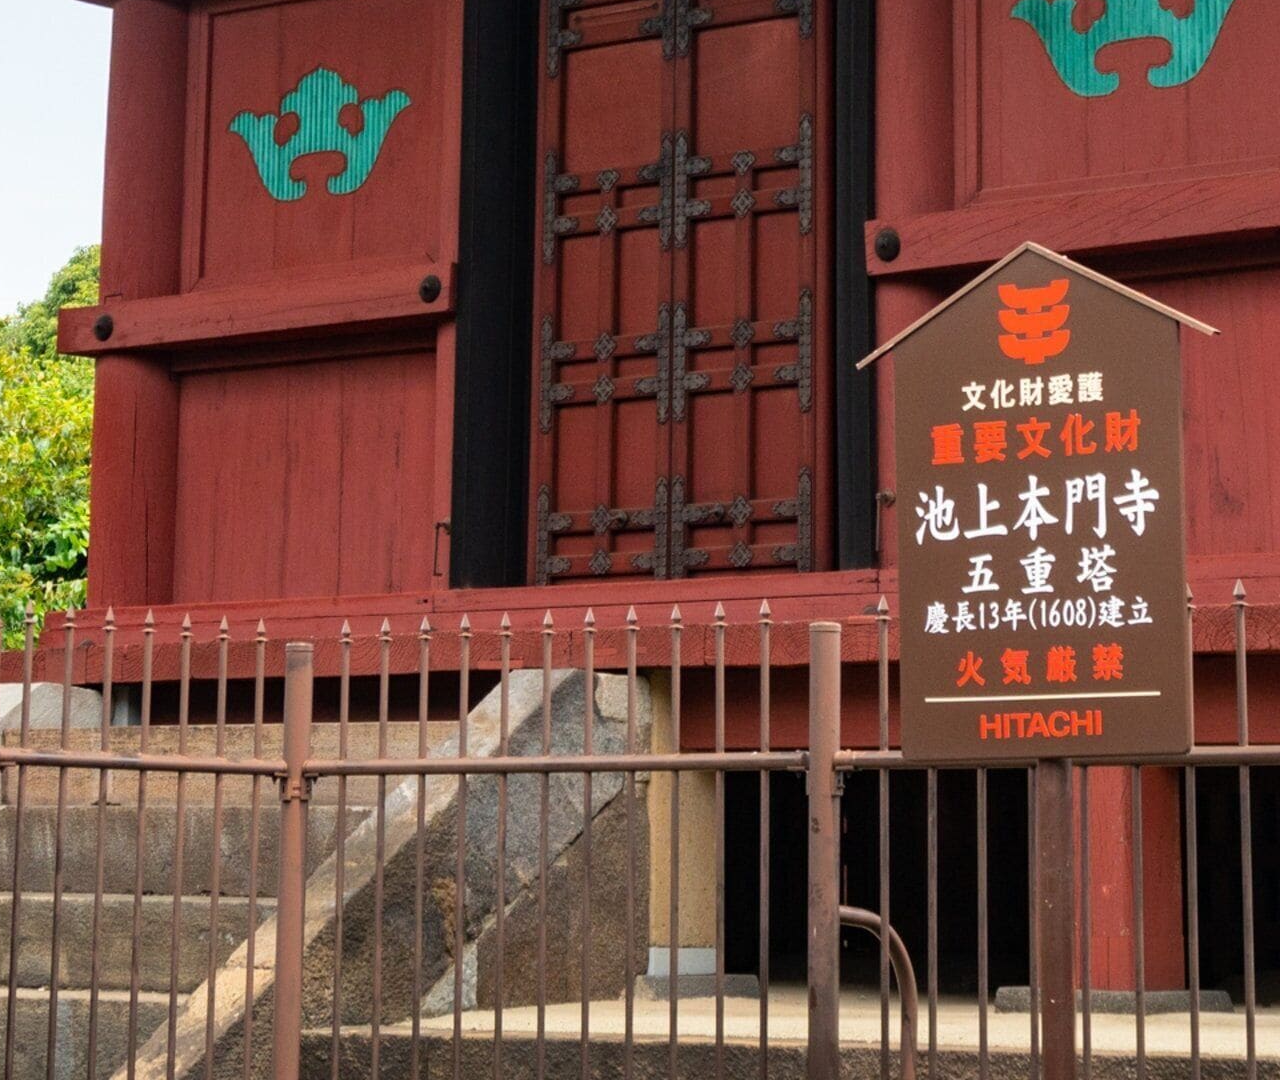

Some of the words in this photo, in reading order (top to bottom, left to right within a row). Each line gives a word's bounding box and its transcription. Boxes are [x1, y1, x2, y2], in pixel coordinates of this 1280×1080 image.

[962, 371, 1104, 411] 文化財愛護
[931, 409, 1141, 465] 重要文化財
[915, 468, 1160, 545] 池上本門寺
[961, 544, 1118, 594] 五重塔
[924, 595, 1153, 634] 慶長13年(1608)建立
[957, 643, 1123, 687] 火気厳禁
[980, 710, 1102, 739] HITACHI
